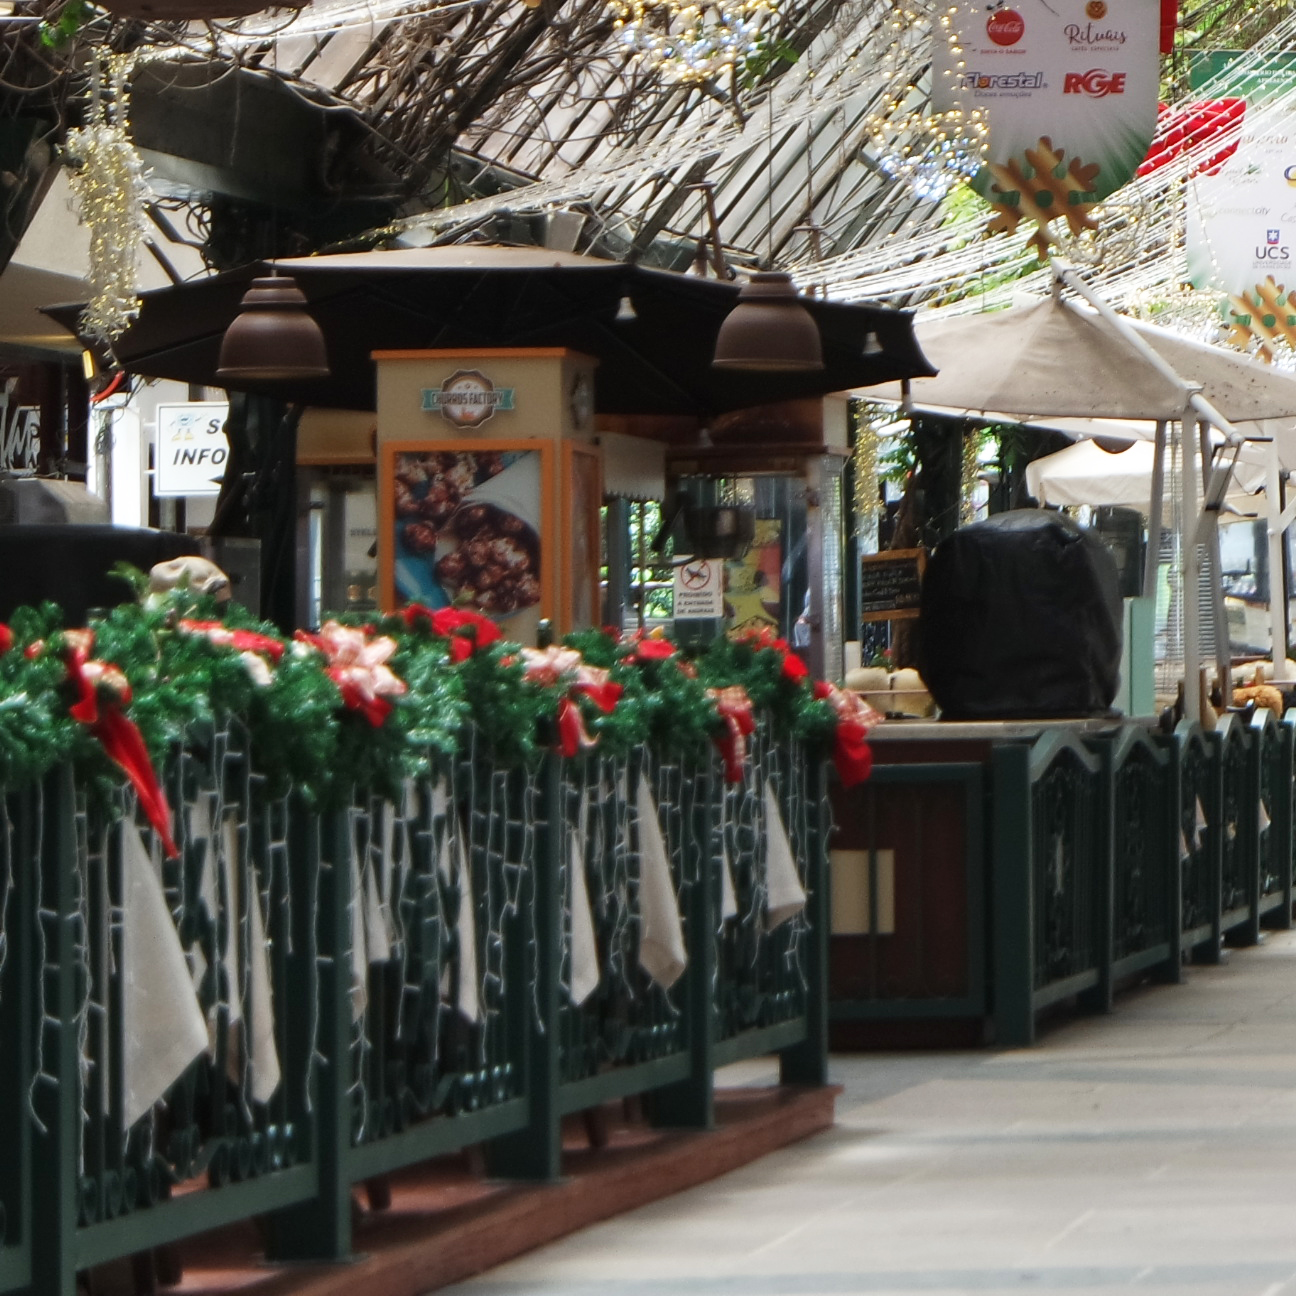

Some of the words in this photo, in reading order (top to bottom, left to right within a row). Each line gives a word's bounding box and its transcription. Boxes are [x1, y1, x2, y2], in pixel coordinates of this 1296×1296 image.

[1063, 22, 1127, 45] Rituais
[960, 71, 1043, 89] Florestal
[1063, 68, 1127, 99] RGE
[1255, 246, 1290, 260] UCS
[431, 392, 468, 405] CHURROS
[469, 392, 504, 405] FACTORY
